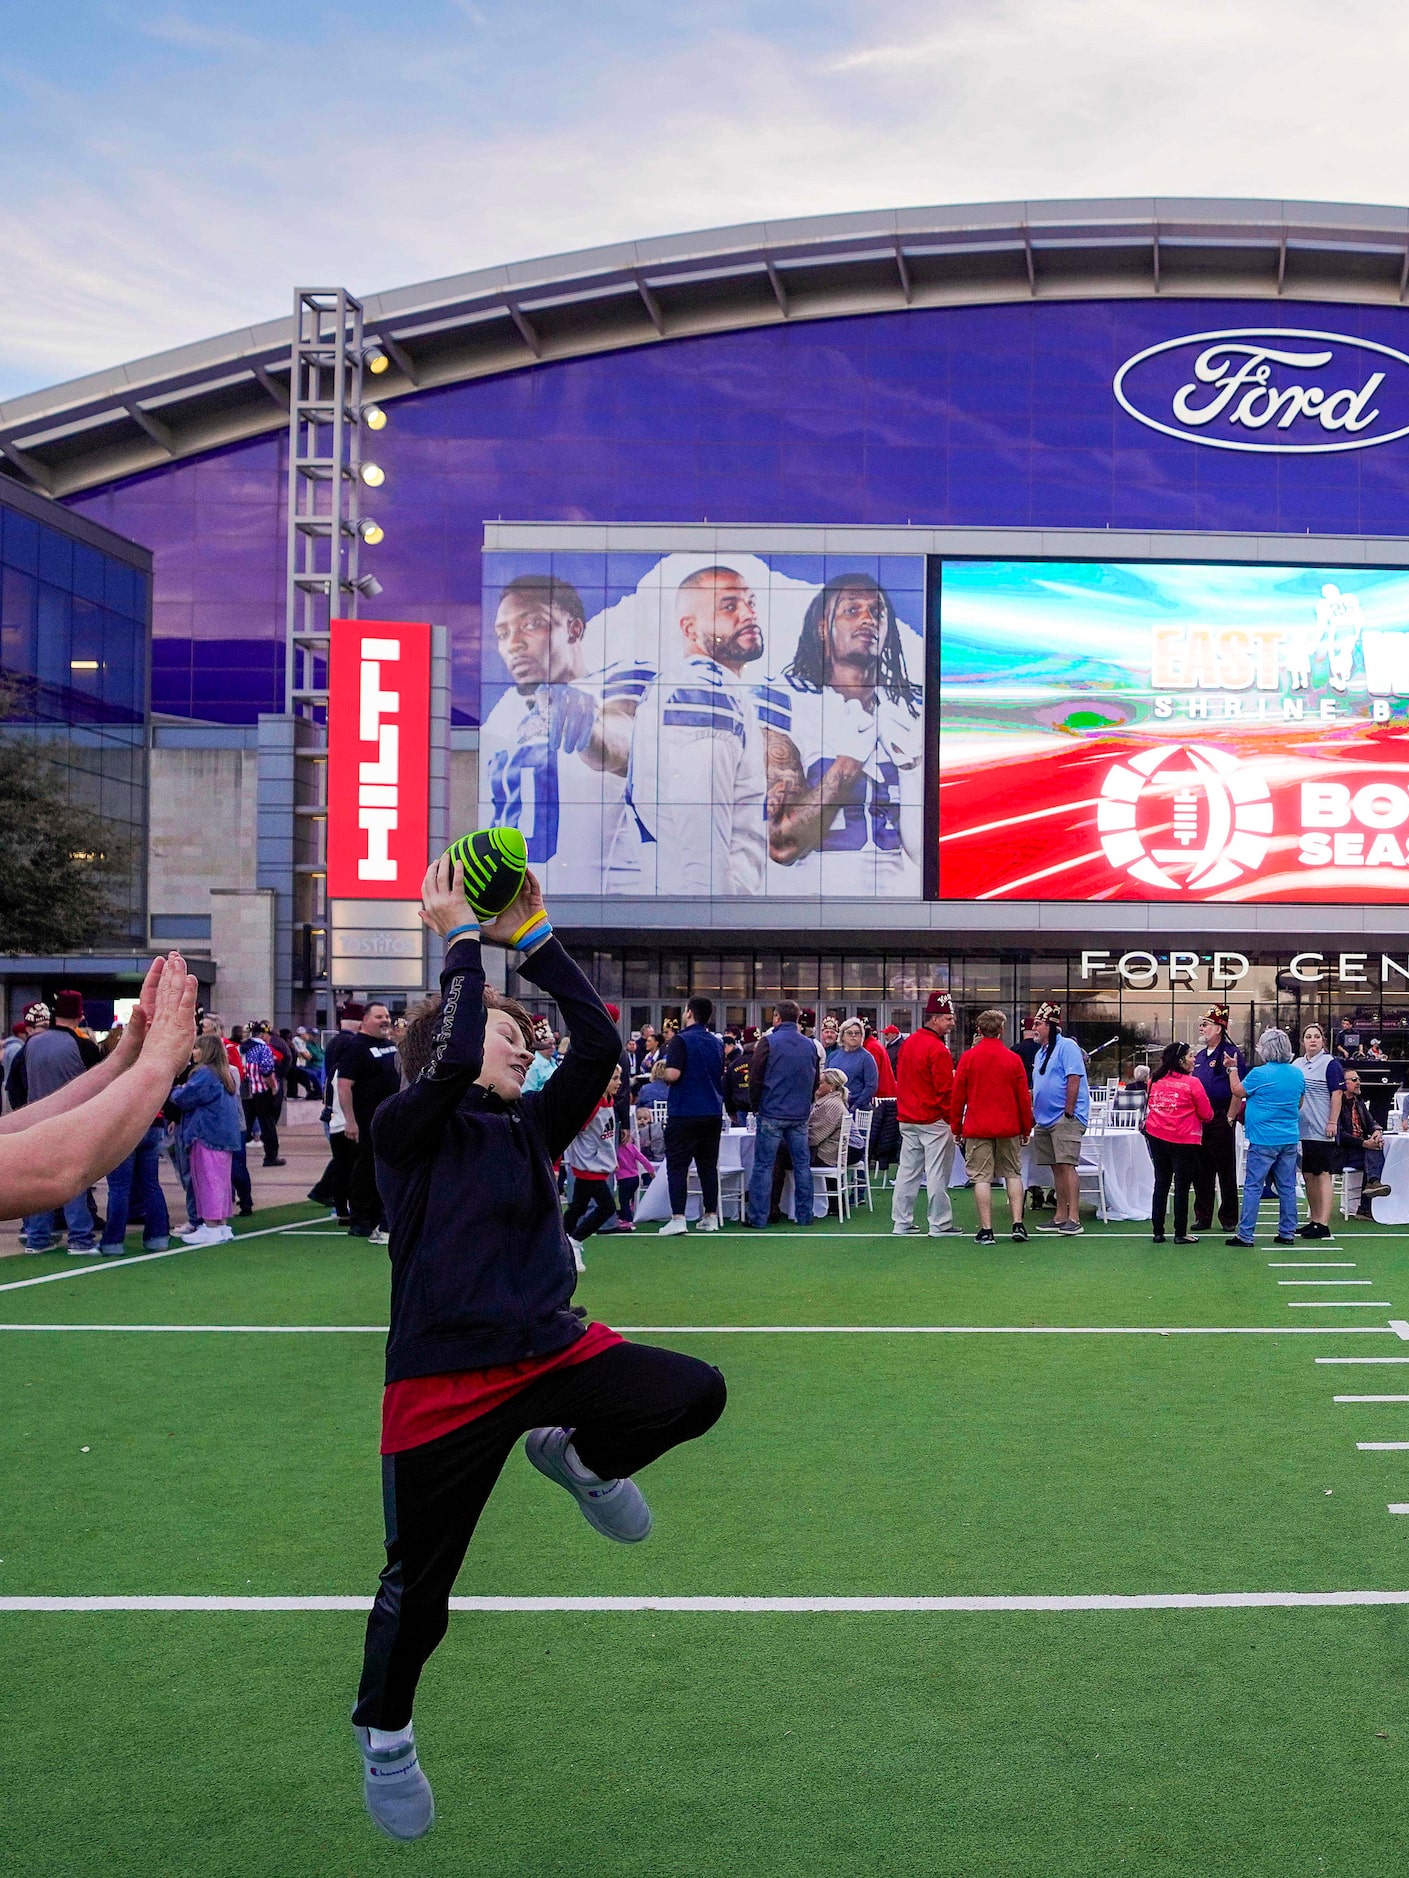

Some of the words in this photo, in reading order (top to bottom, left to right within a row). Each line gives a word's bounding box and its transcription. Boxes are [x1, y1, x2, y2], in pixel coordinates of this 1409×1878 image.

[1172, 343, 1386, 432] Ford
[1153, 626, 1284, 689] EAST
[1154, 698, 1337, 722] SHRINE
[1081, 950, 1250, 981] FORD
